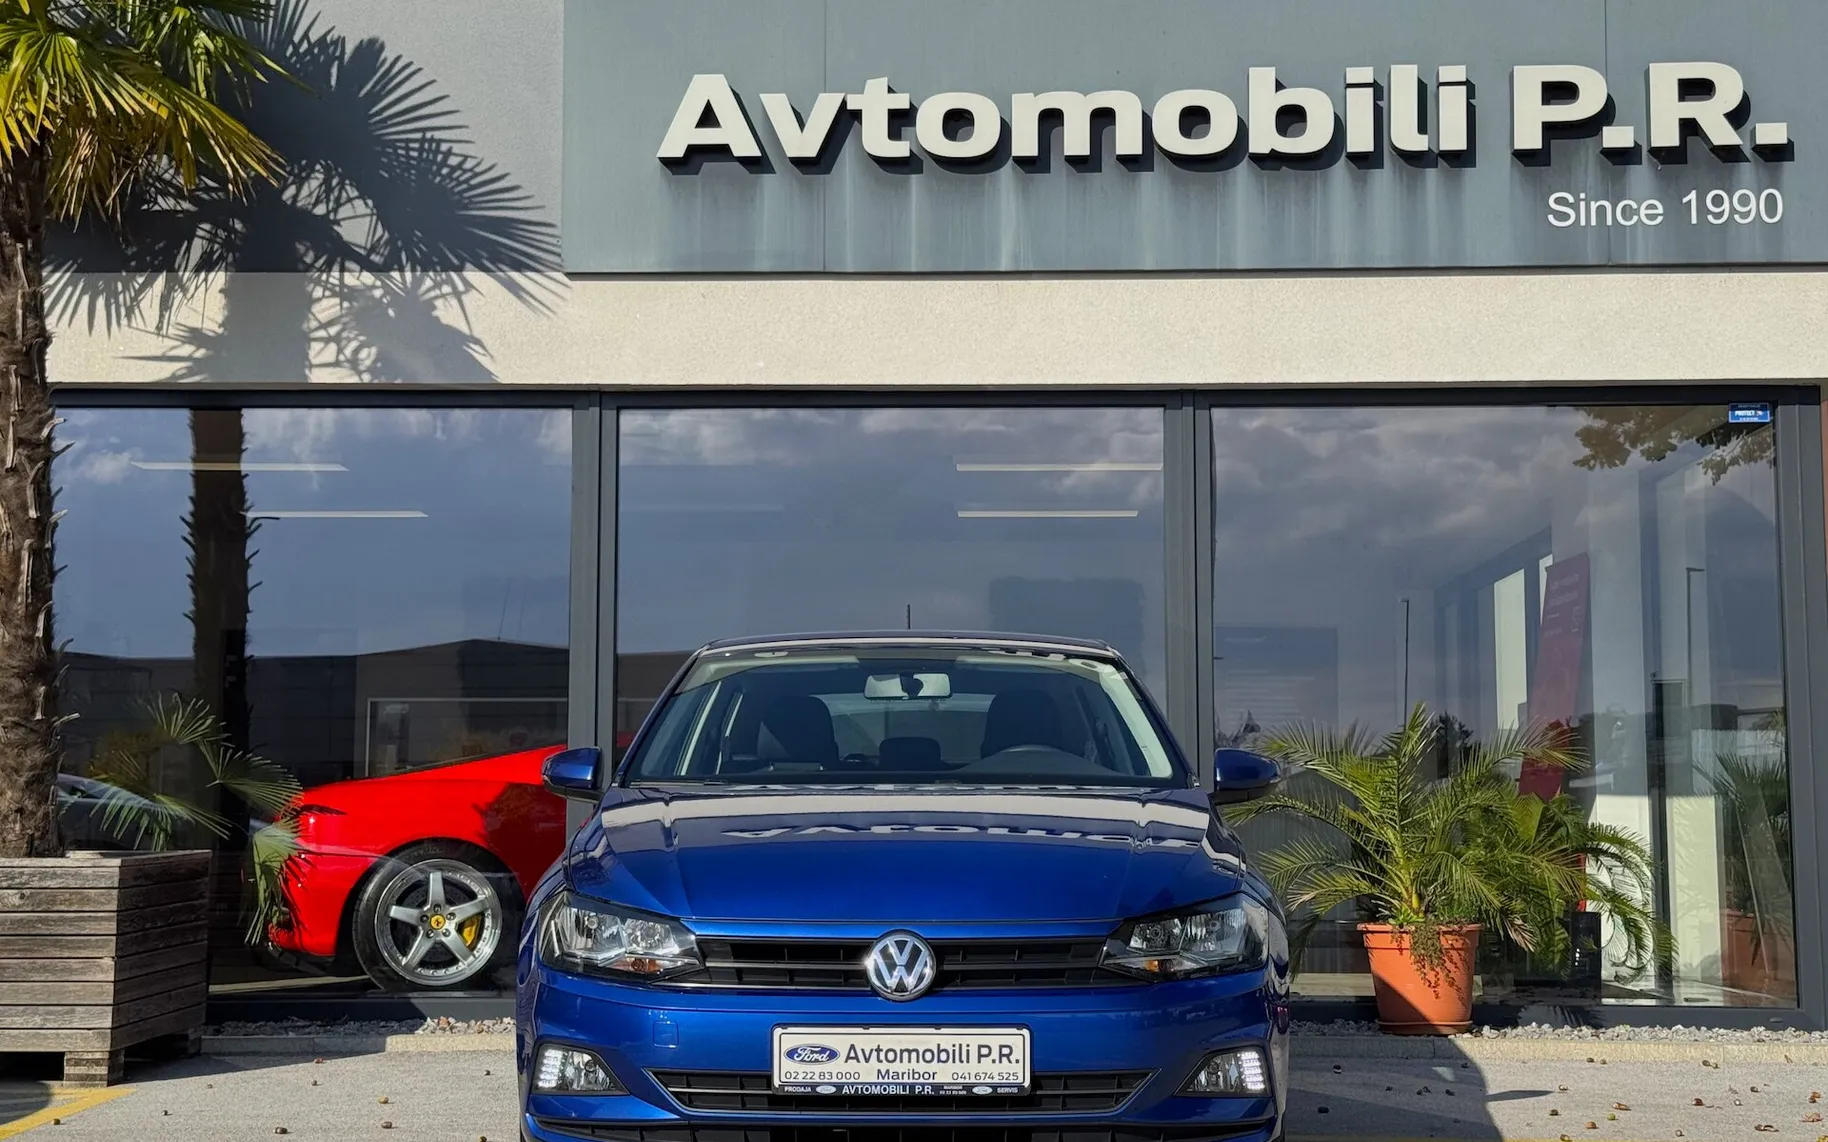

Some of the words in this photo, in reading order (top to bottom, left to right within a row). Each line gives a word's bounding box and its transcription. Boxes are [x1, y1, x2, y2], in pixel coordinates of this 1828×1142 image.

[656, 64, 1468, 158] Avtomobili
[1512, 61, 1789, 151] P.R.
[1546, 190, 1665, 228] Since
[1681, 187, 1785, 226] 1990
[843, 1043, 971, 1065] Avtomobili
[976, 1043, 1021, 1065] P.R.
[784, 1070, 800, 1081] 02
[801, 1070, 817, 1081] 22
[818, 1071, 833, 1081] 83
[835, 1071, 861, 1081] 000
[876, 1068, 938, 1081] Maribor
[951, 1071, 972, 1081] 041
[973, 1071, 995, 1081] 674
[997, 1071, 1019, 1081] 525
[841, 1085, 910, 1095] AVTOMOBILI
[914, 1085, 935, 1095] P.R.
[996, 1086, 1019, 1094] SERVIS
